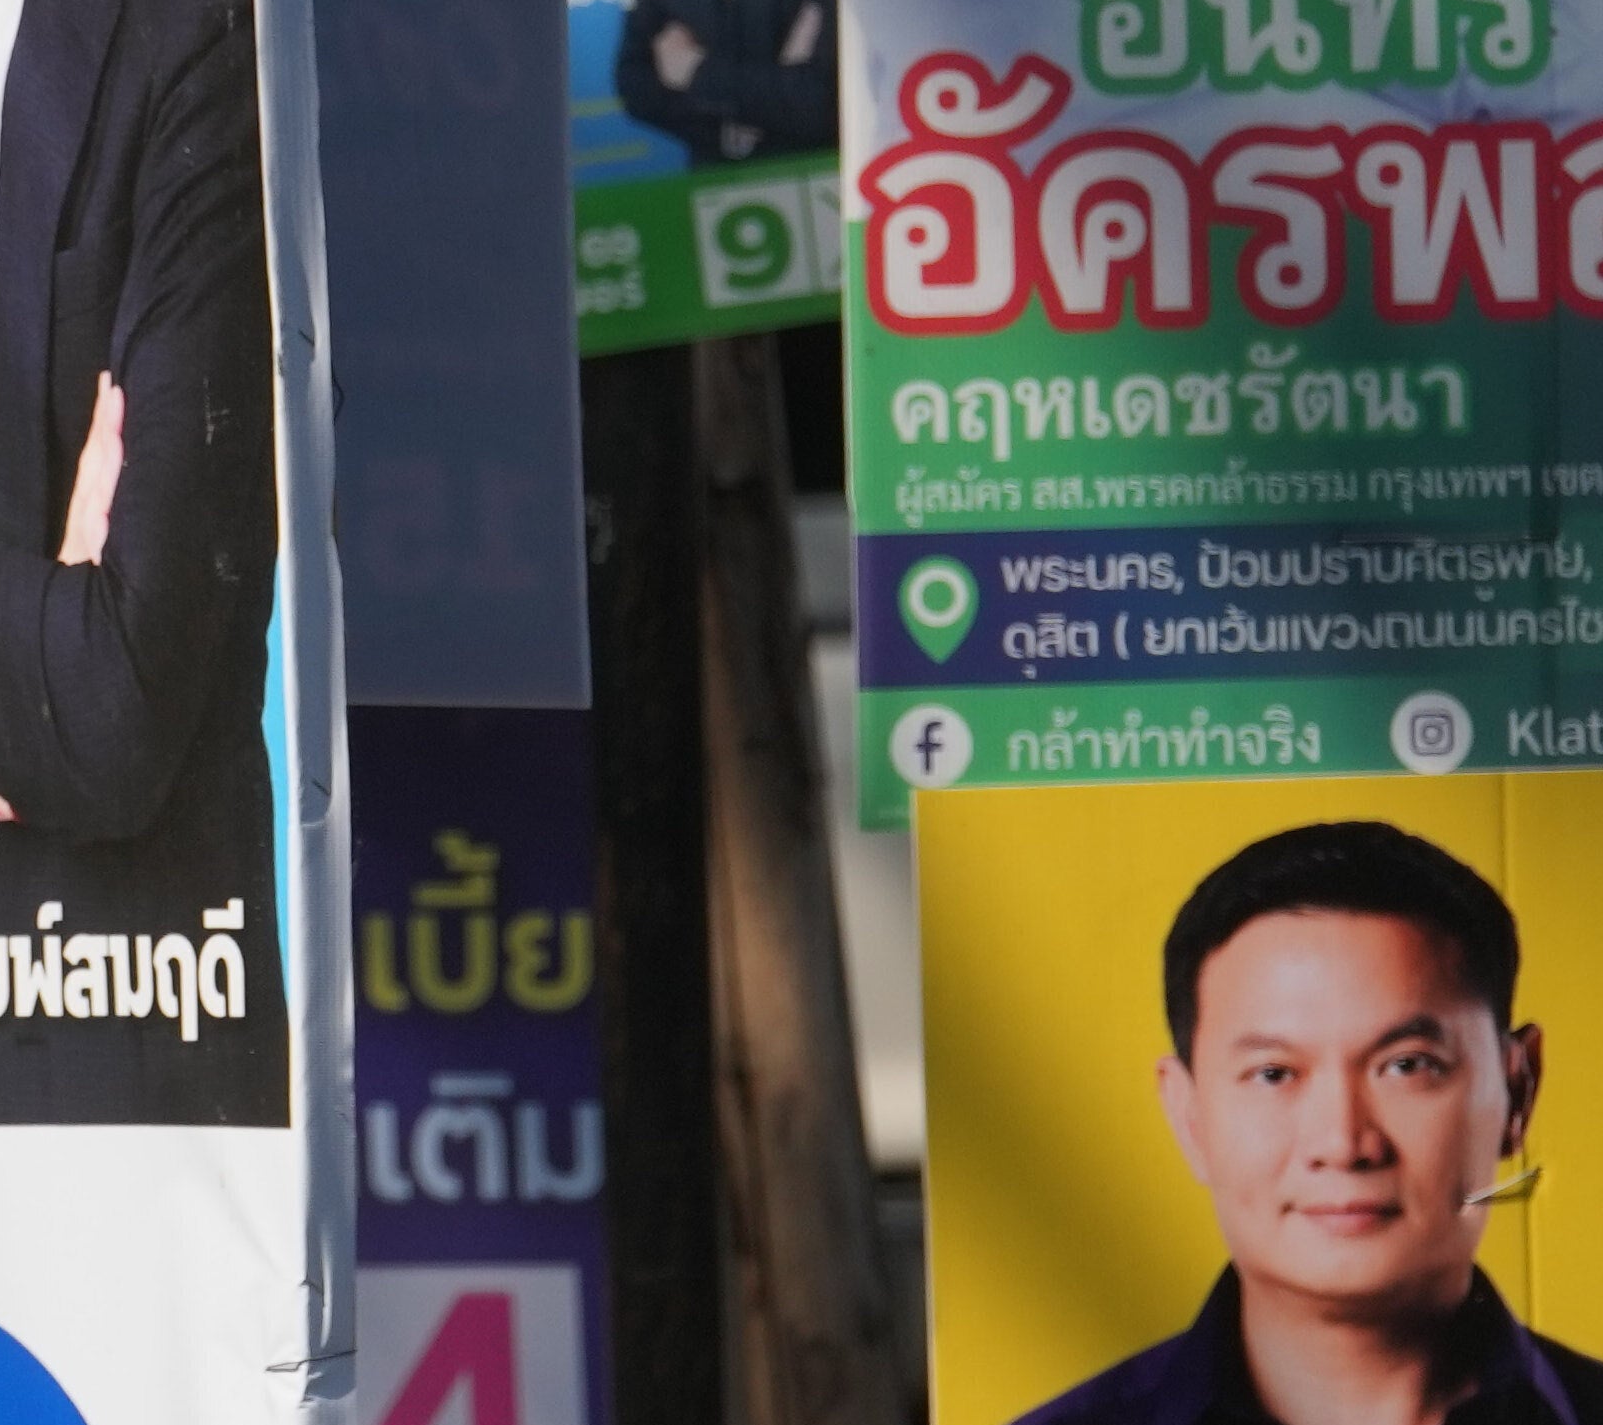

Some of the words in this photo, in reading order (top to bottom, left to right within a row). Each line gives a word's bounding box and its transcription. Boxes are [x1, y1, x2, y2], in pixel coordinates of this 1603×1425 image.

[717, 203, 792, 288] 9
[894, 343, 1466, 461] คฤหเดชรัตนา
[896, 464, 1024, 528] ผู้สมัคร
[1369, 462, 1533, 516] กรุงเทพฯ
[1001, 550, 1185, 596] พระนคร,
[1002, 610, 1100, 680] ดุสิต
[1007, 702, 1322, 772] กล้าทำทำจริง
[363, 828, 593, 1014] เบี้ย
[363, 1070, 604, 1203] เติม
